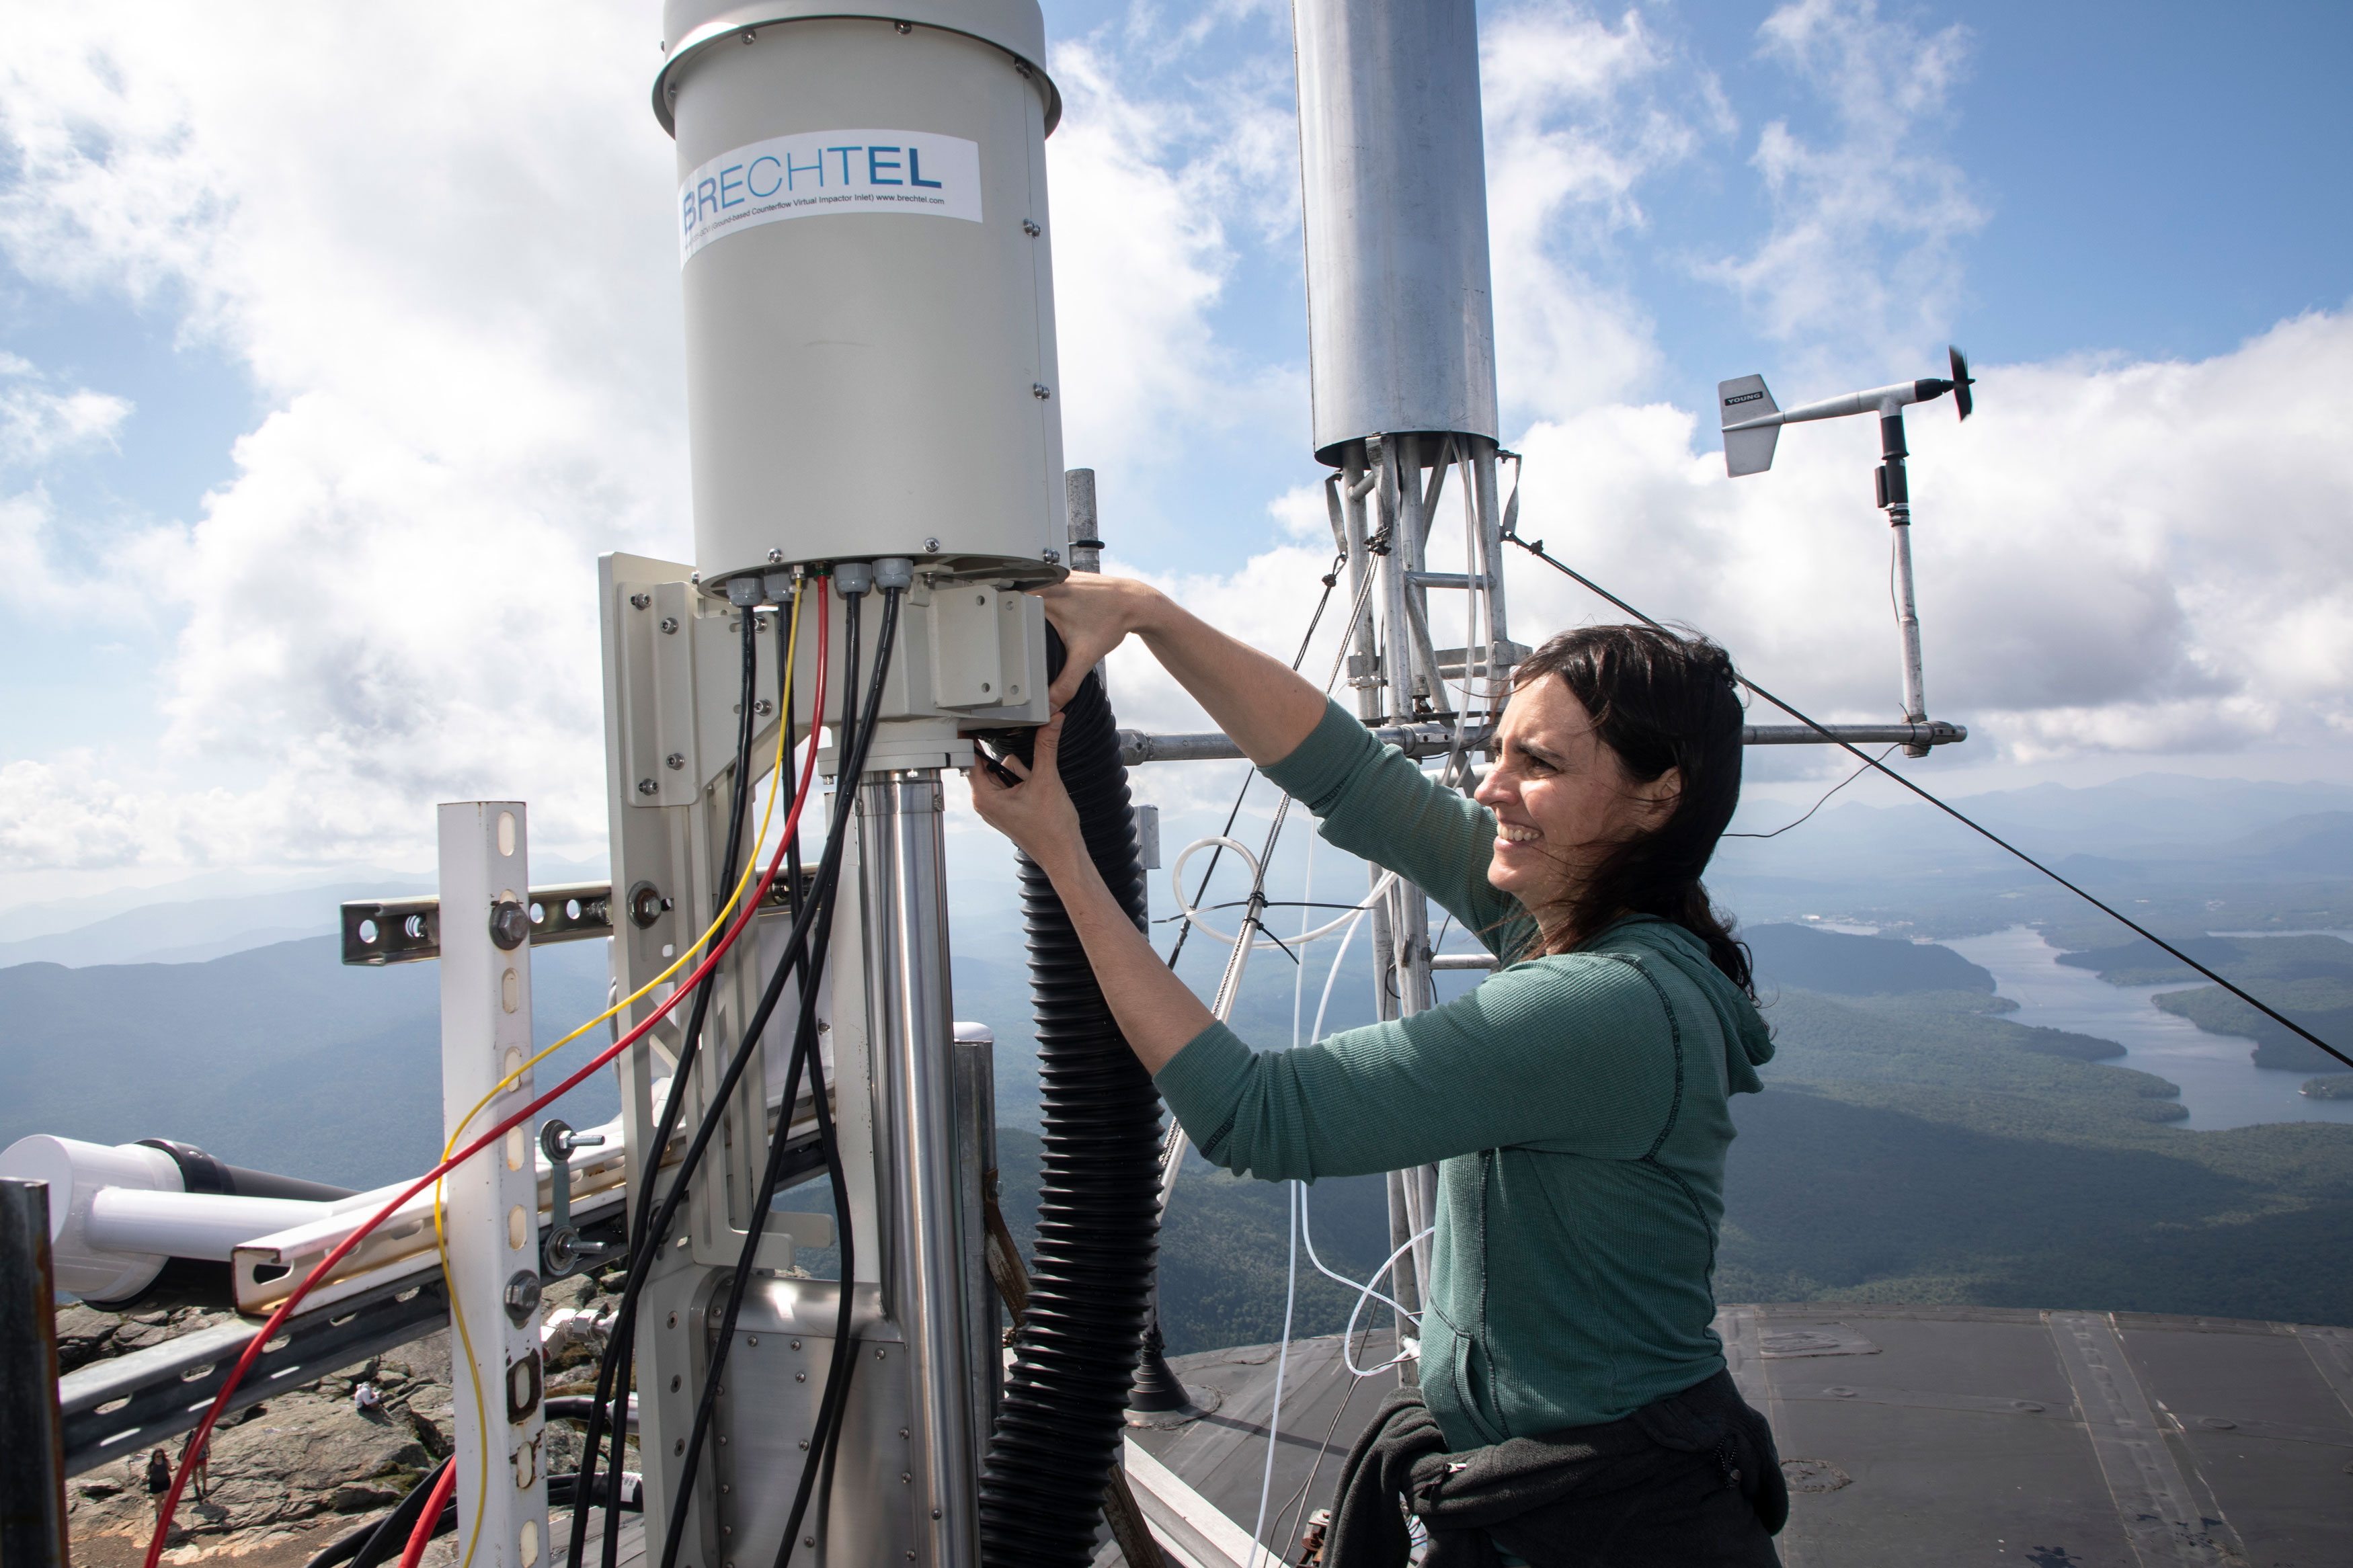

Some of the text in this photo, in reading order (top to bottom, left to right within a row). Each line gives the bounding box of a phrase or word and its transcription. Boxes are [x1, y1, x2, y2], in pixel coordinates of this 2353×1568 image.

[683, 146, 943, 235] BRECHTEL
[711, 210, 751, 232] (Ground-based
[752, 202, 792, 216] Counterflow
[793, 196, 817, 207] Virtual
[819, 195, 852, 204] Impactor
[854, 194, 874, 202] Inlet)
[876, 194, 945, 204] www.brechtel.com
[1727, 393, 1761, 404] YOUNG
